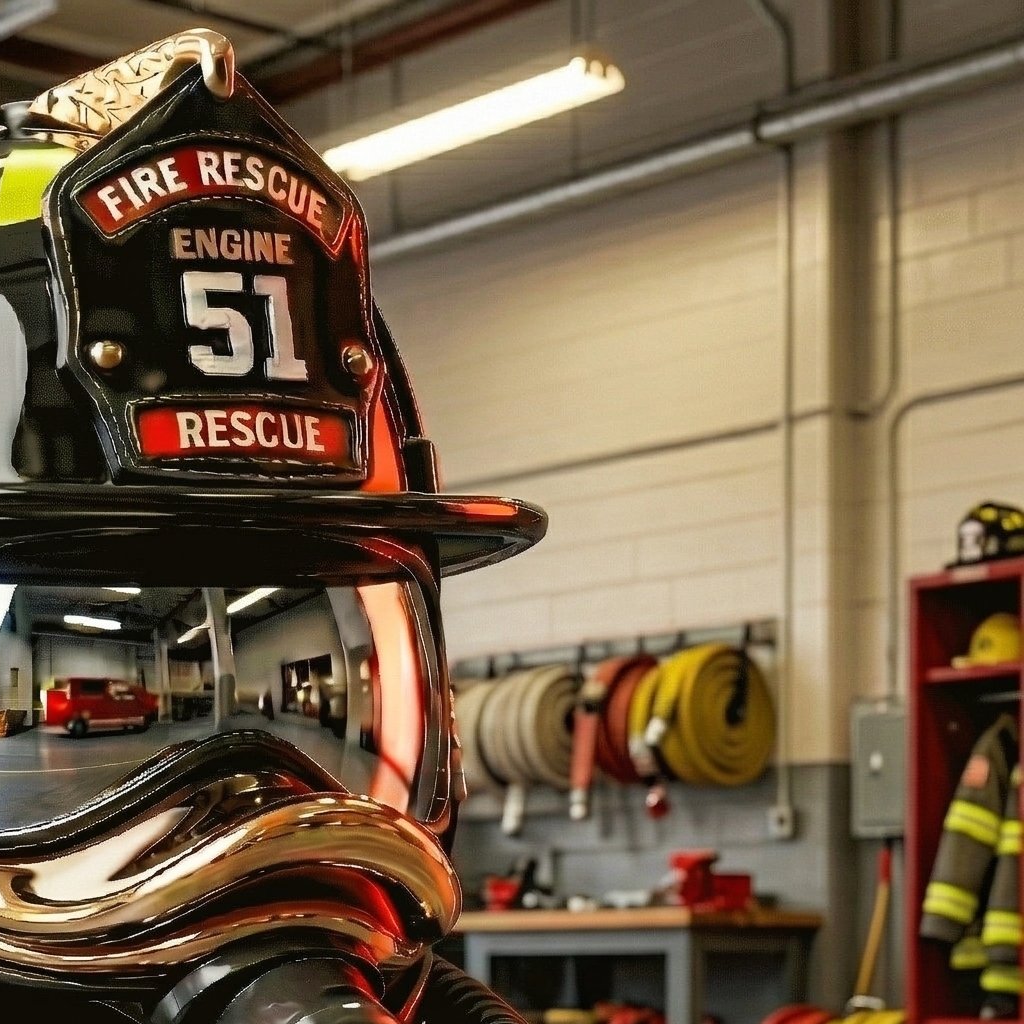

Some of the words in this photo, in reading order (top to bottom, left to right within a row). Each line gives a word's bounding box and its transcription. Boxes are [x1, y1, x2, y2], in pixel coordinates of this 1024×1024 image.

[96, 157, 188, 222] FIRE
[196, 150, 328, 229] RESCUE
[171, 227, 294, 265] ENGINE
[181, 270, 309, 382] 51
[176, 410, 326, 452] RESCUE
